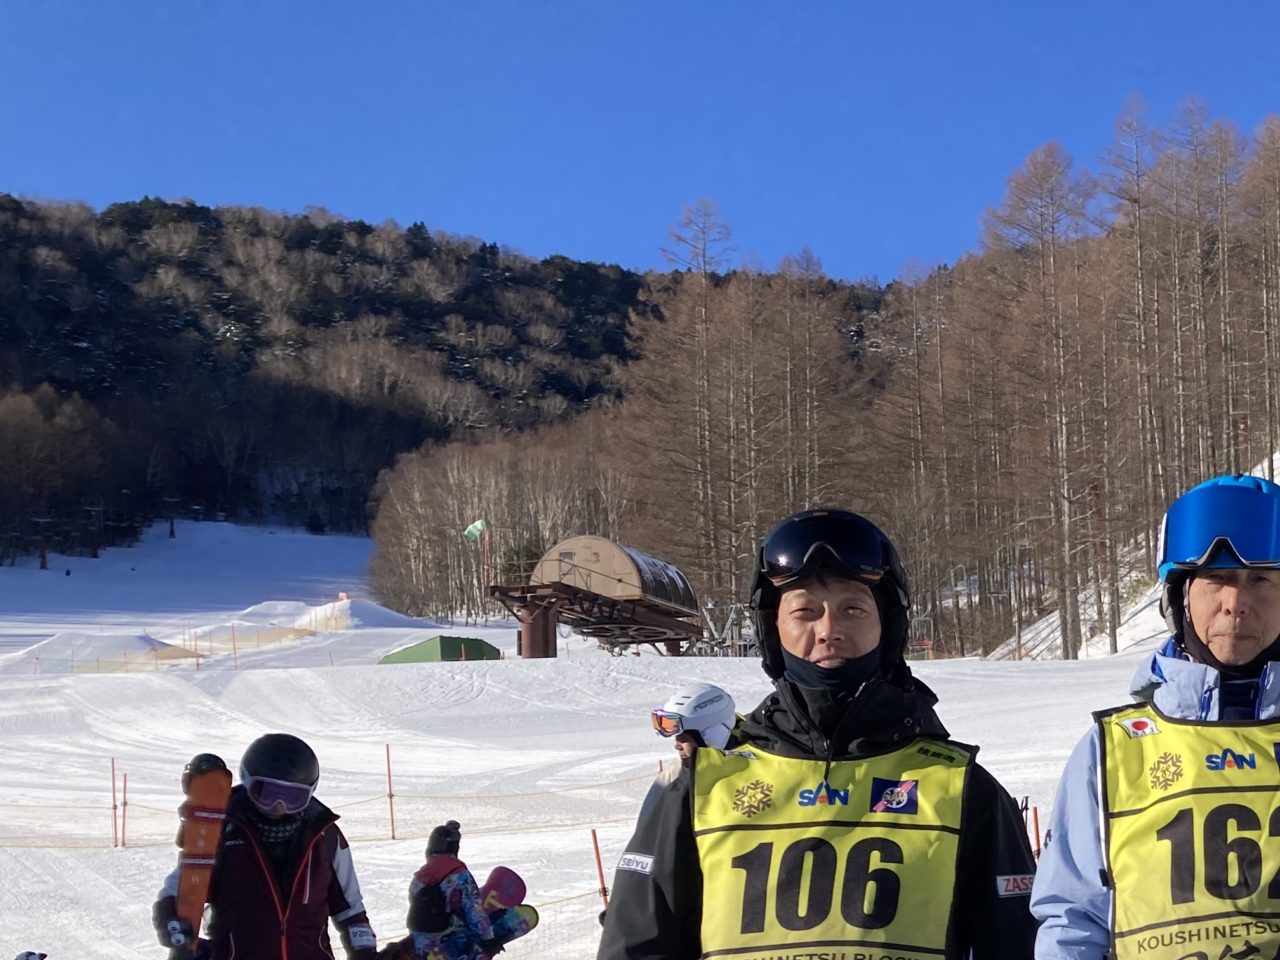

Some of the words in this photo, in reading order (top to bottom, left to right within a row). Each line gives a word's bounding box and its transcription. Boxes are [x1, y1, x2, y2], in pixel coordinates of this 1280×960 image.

[1205, 748, 1256, 771] SAN
[799, 780, 849, 807] SAN
[731, 837, 904, 934] 106
[1137, 921, 1280, 954] KOUSHINETSU
